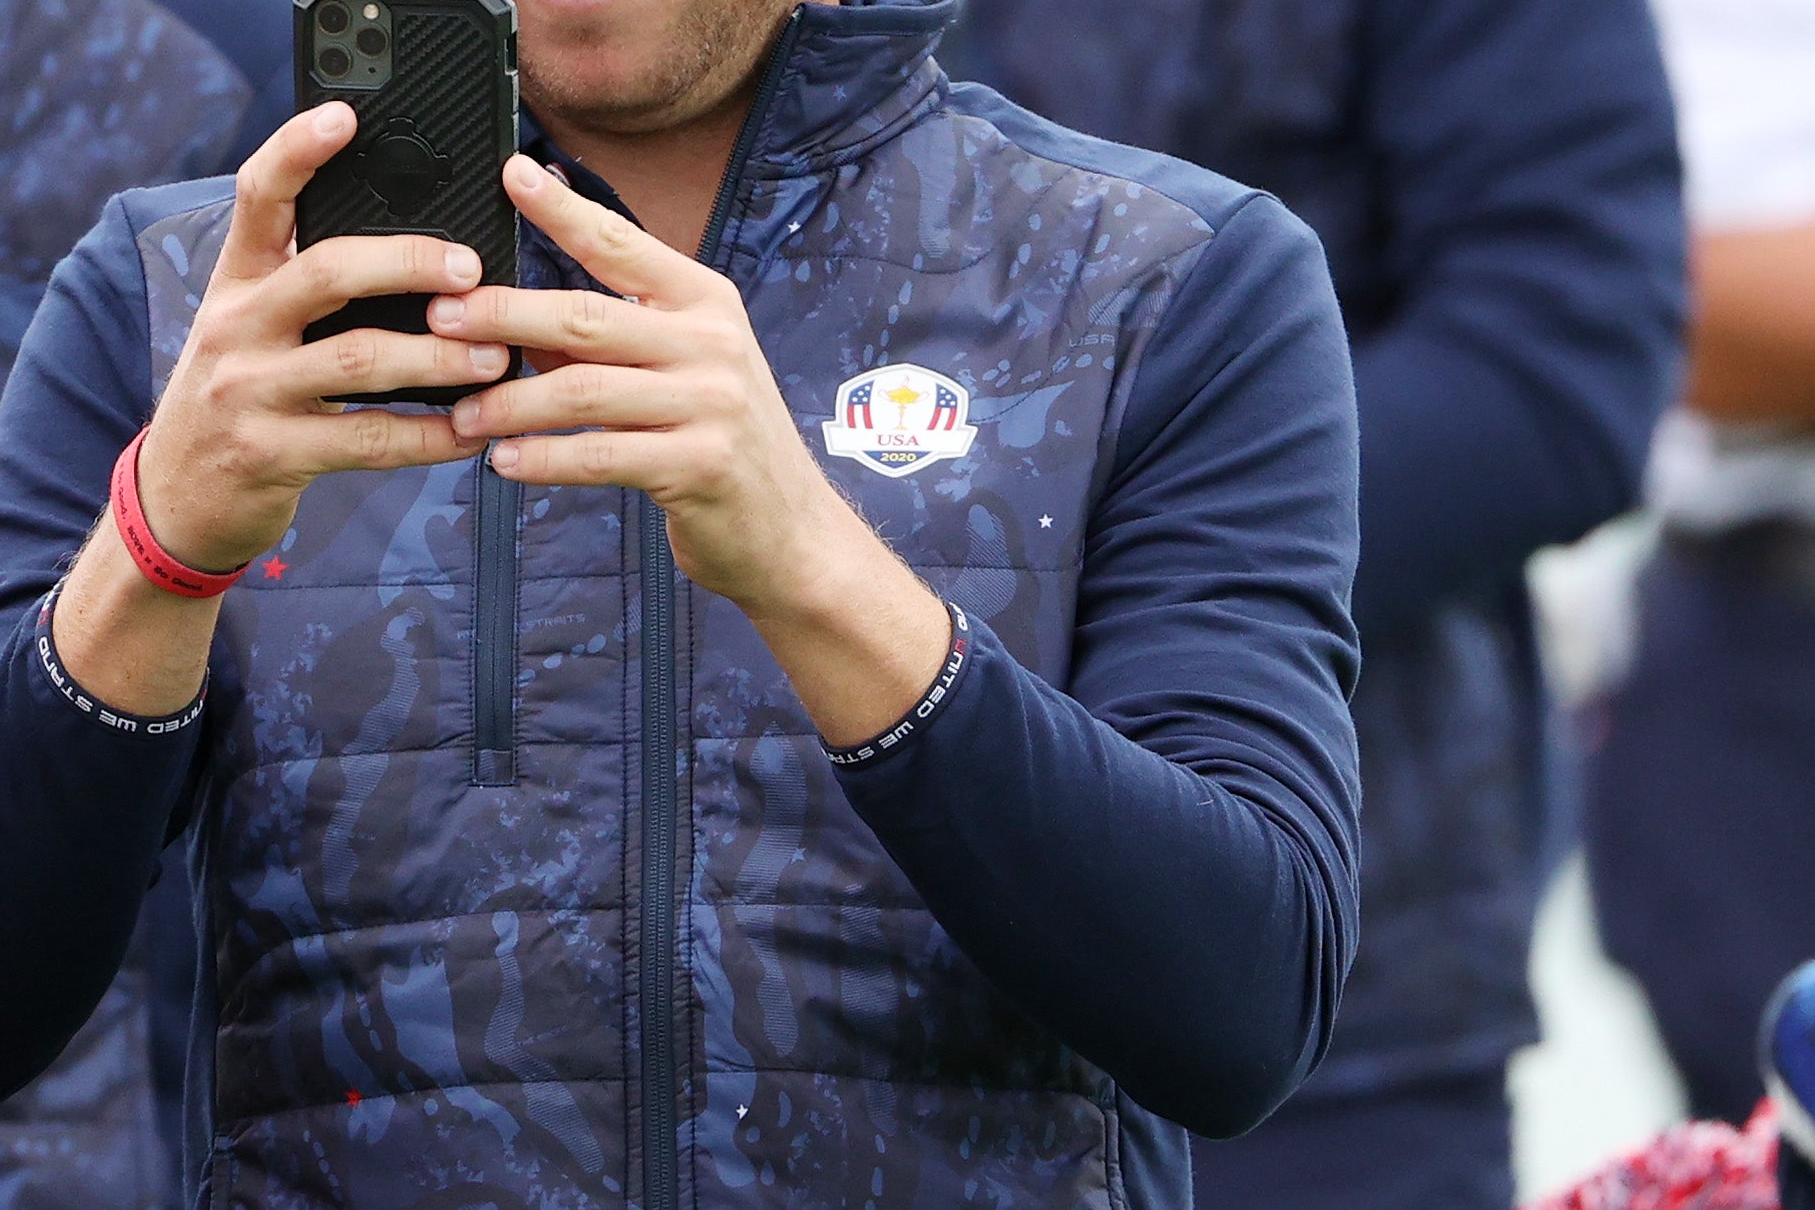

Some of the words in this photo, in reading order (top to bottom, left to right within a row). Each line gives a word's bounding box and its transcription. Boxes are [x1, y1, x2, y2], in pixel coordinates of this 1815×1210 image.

[877, 434, 920, 446] USA
[880, 452, 917, 462] 2020
[39, 636, 94, 713] STAND
[917, 639, 968, 718] UNITED
[98, 710, 137, 733] WE
[879, 721, 914, 749] WE
[821, 746, 875, 764] STA
